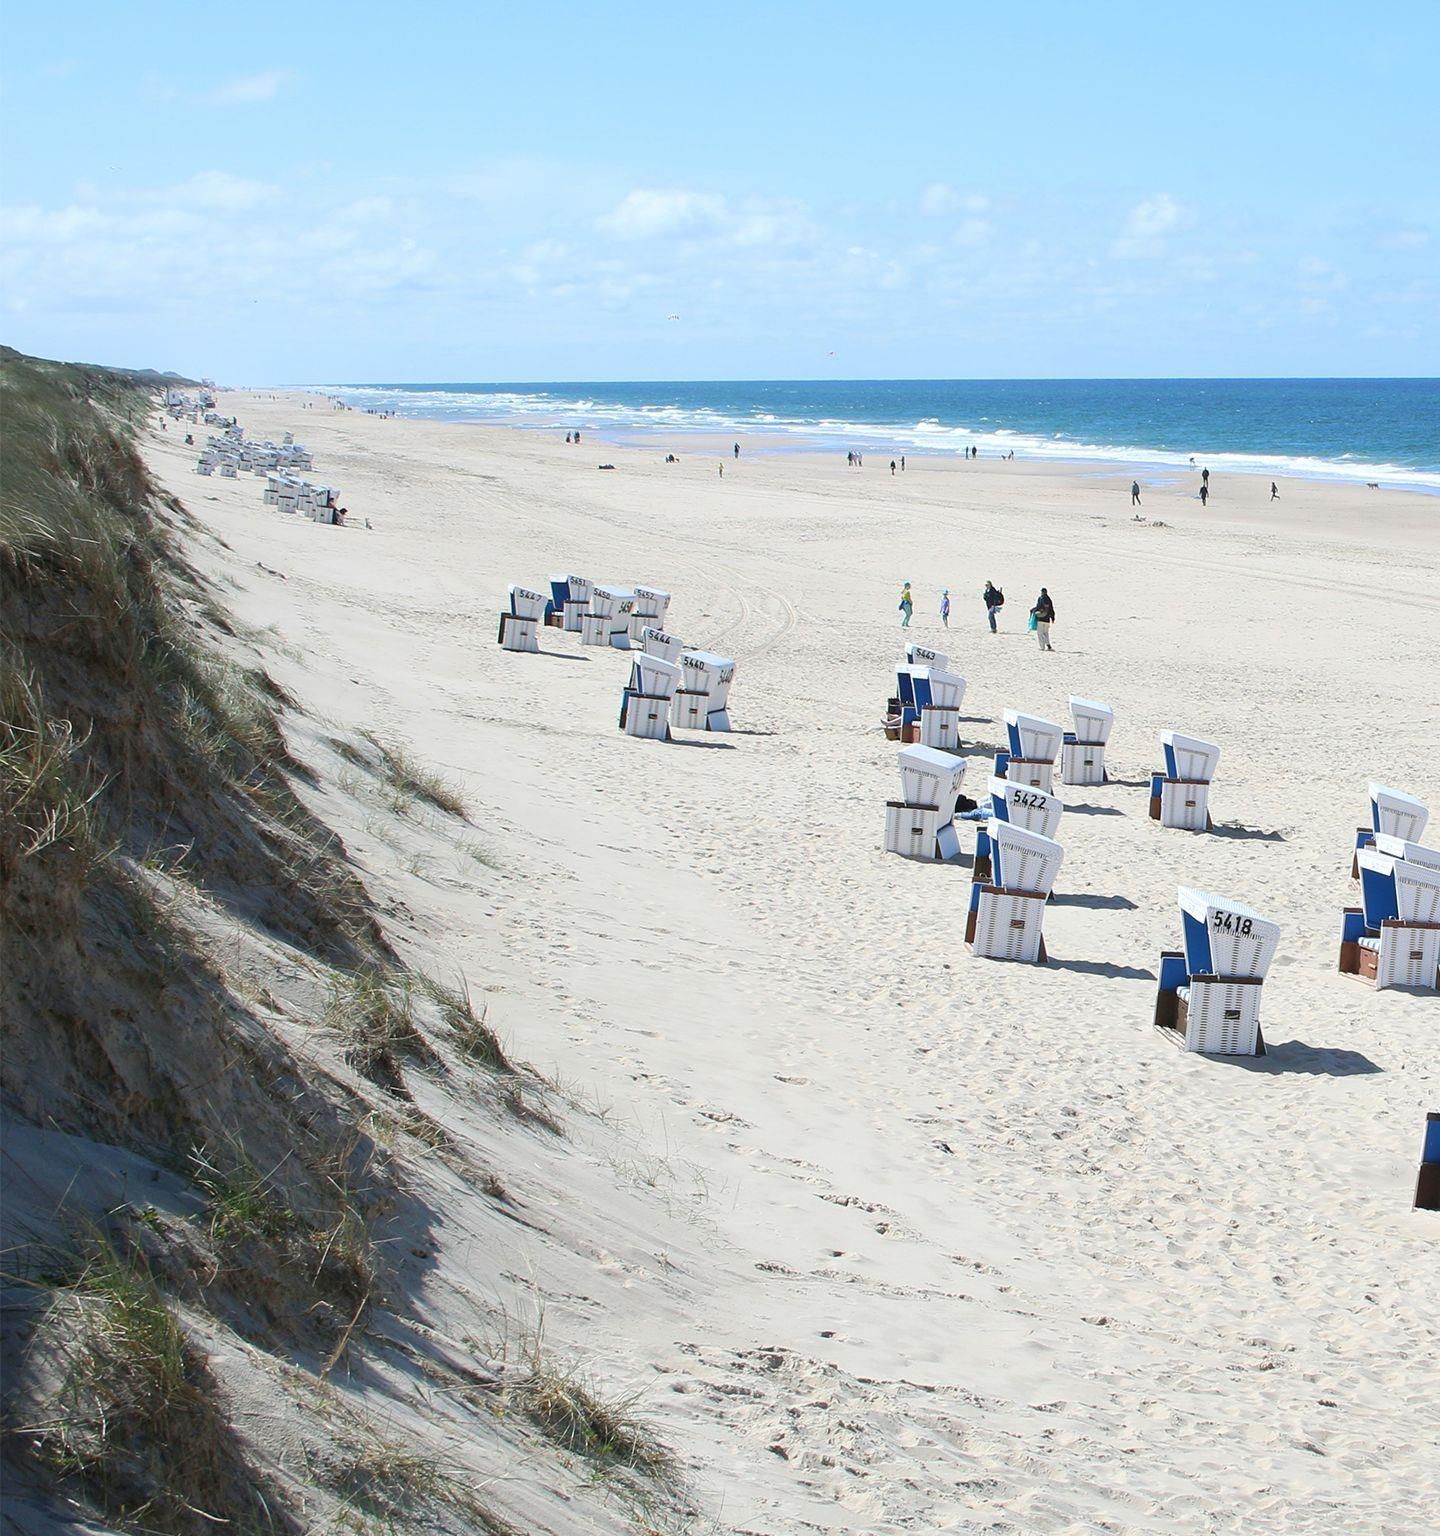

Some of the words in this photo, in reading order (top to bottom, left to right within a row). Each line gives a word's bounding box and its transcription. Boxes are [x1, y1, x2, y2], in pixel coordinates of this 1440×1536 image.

[519, 590, 542, 602] 5447
[648, 630, 671, 645] 5444
[916, 648, 936, 660] 5443
[683, 656, 705, 671] 5440
[1013, 790, 1047, 810] 5422
[1213, 911, 1253, 935] 5418
